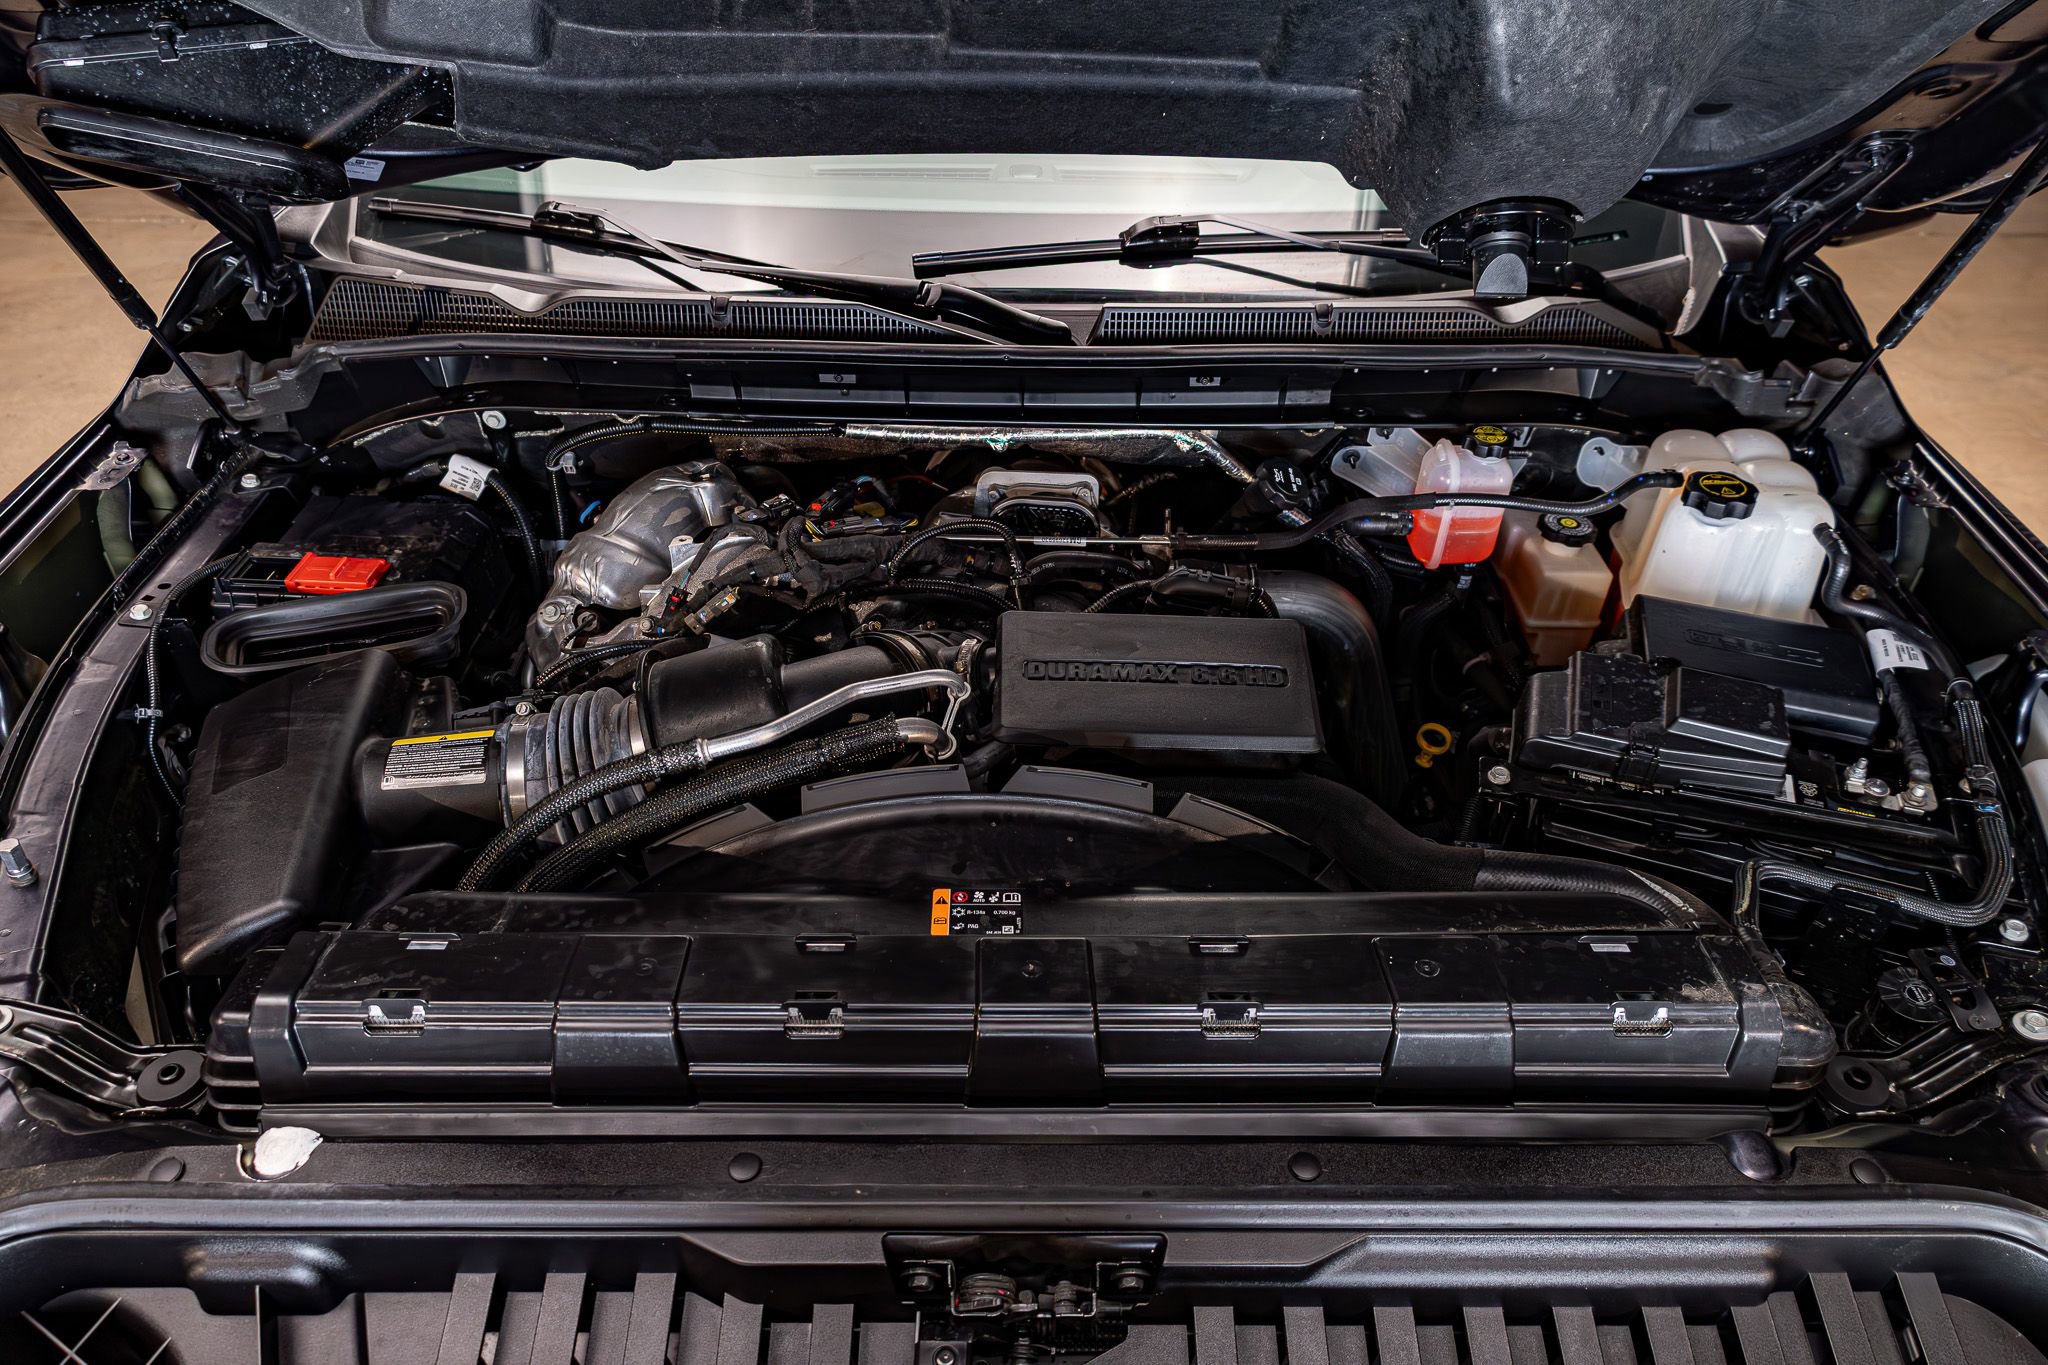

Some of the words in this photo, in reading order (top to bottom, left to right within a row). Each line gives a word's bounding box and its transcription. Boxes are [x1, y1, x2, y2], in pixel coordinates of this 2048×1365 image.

[1027, 661, 1179, 683] DURAMAX
[1192, 665, 1239, 685] 6.6
[1246, 668, 1286, 687] HD
